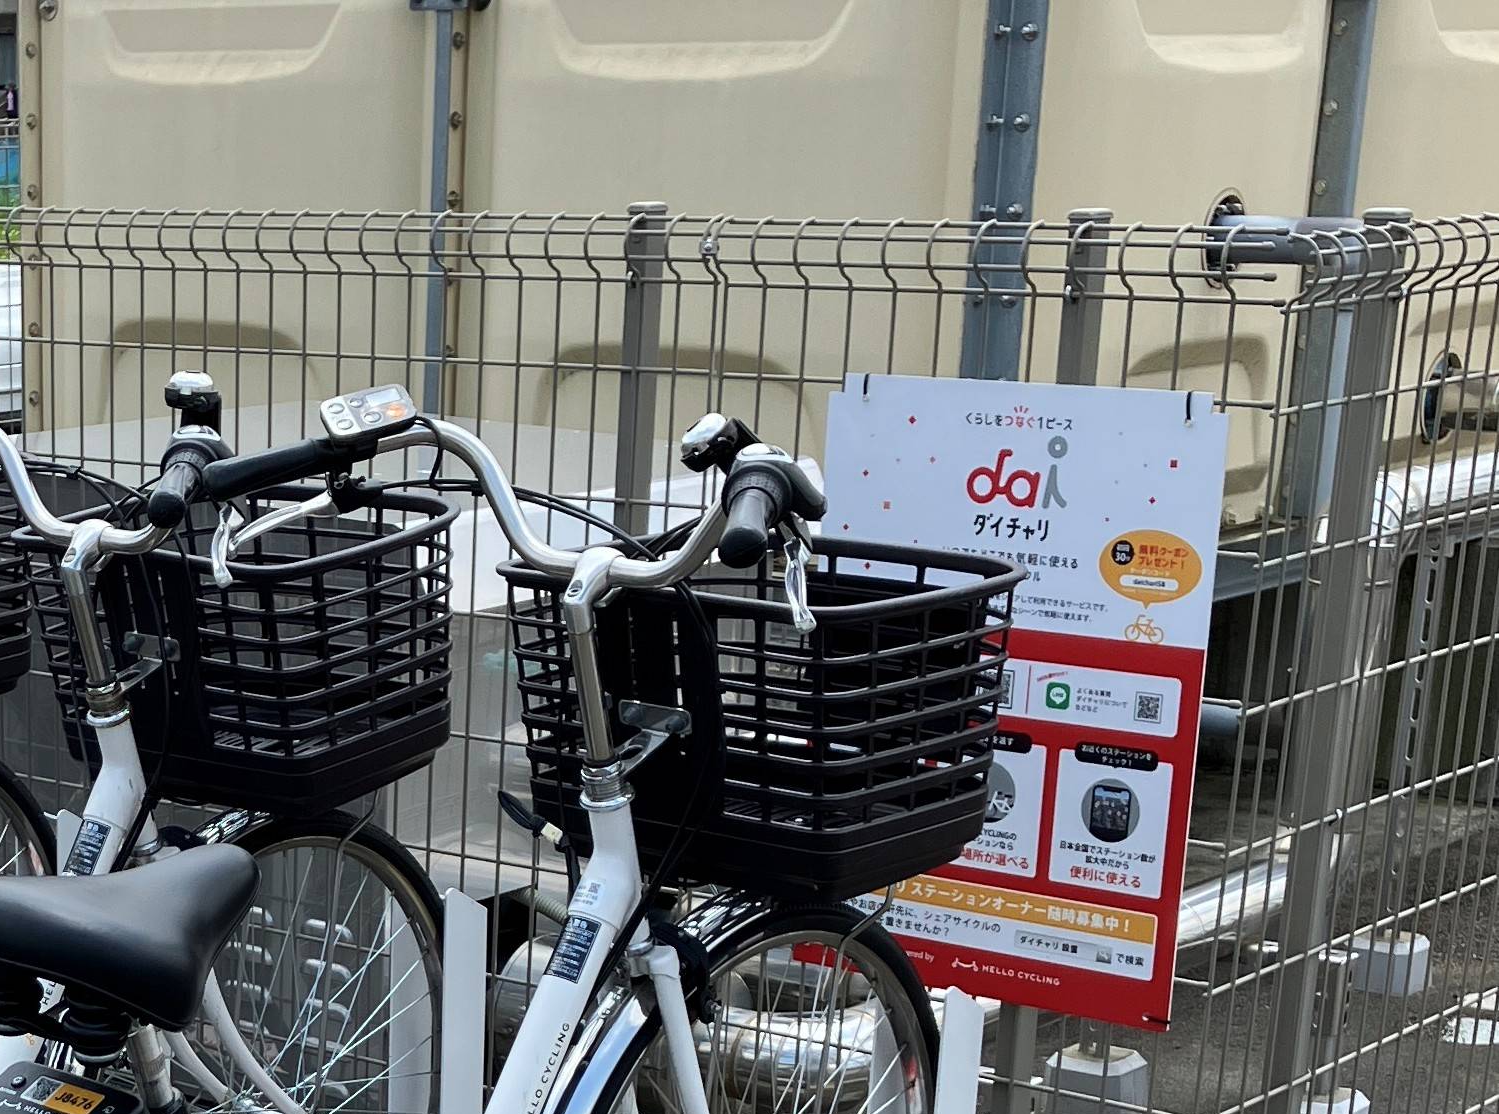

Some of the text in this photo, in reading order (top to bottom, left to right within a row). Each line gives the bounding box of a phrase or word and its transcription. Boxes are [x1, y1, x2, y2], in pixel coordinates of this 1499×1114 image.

[965, 412, 1073, 431] くらしをつなぐ1ピース
[966, 435, 1068, 509] dai
[973, 513, 1049, 541] ダイチャリ
[1070, 865, 1141, 888] 便利に使える
[1115, 952, 1144, 967] で検索
[981, 964, 1061, 986] HELLO CYCLING
[541, 1022, 571, 1084] CYCLING
[54, 1090, 94, 1110] J8476
